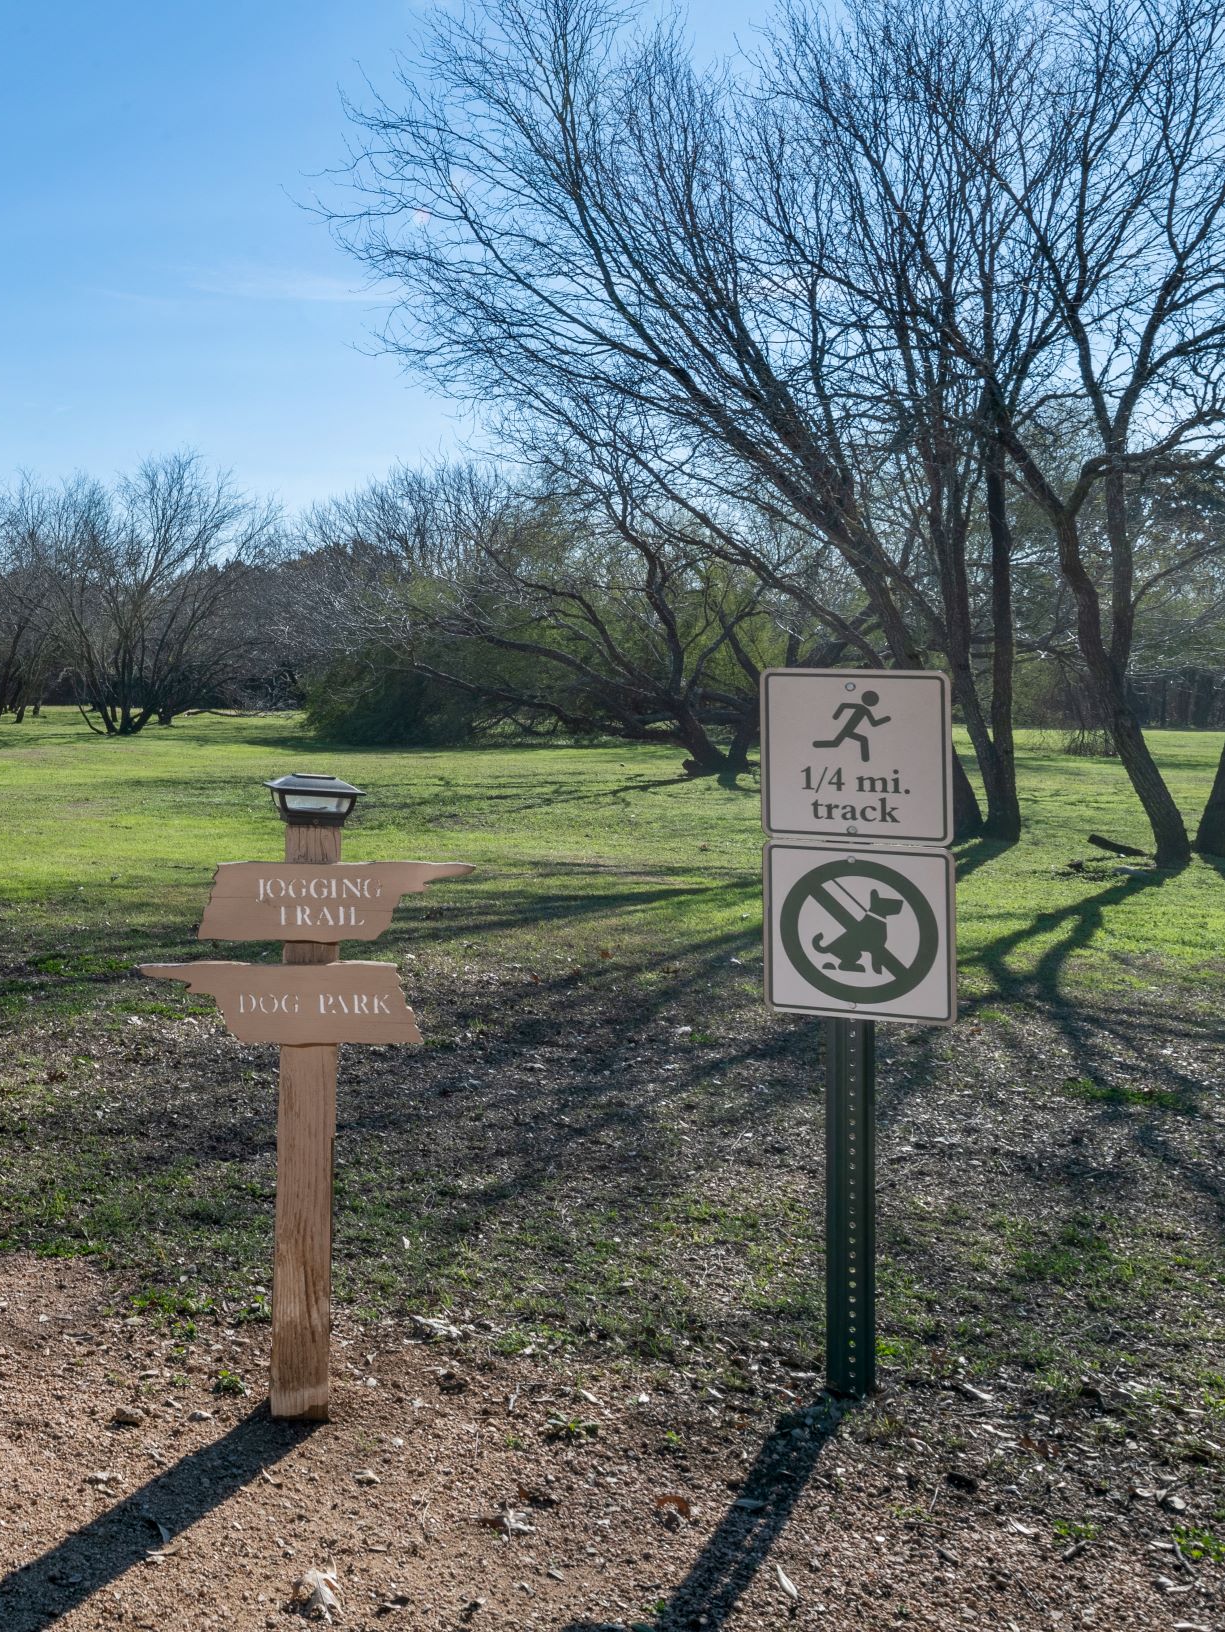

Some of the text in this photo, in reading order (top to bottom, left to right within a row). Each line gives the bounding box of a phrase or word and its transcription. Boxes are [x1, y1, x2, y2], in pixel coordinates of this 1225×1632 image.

[800, 765, 911, 795] 1/4 mi.
[811, 797, 901, 823] track
[255, 878, 383, 904] JOGGING
[238, 993, 391, 1015] DOG PARK
